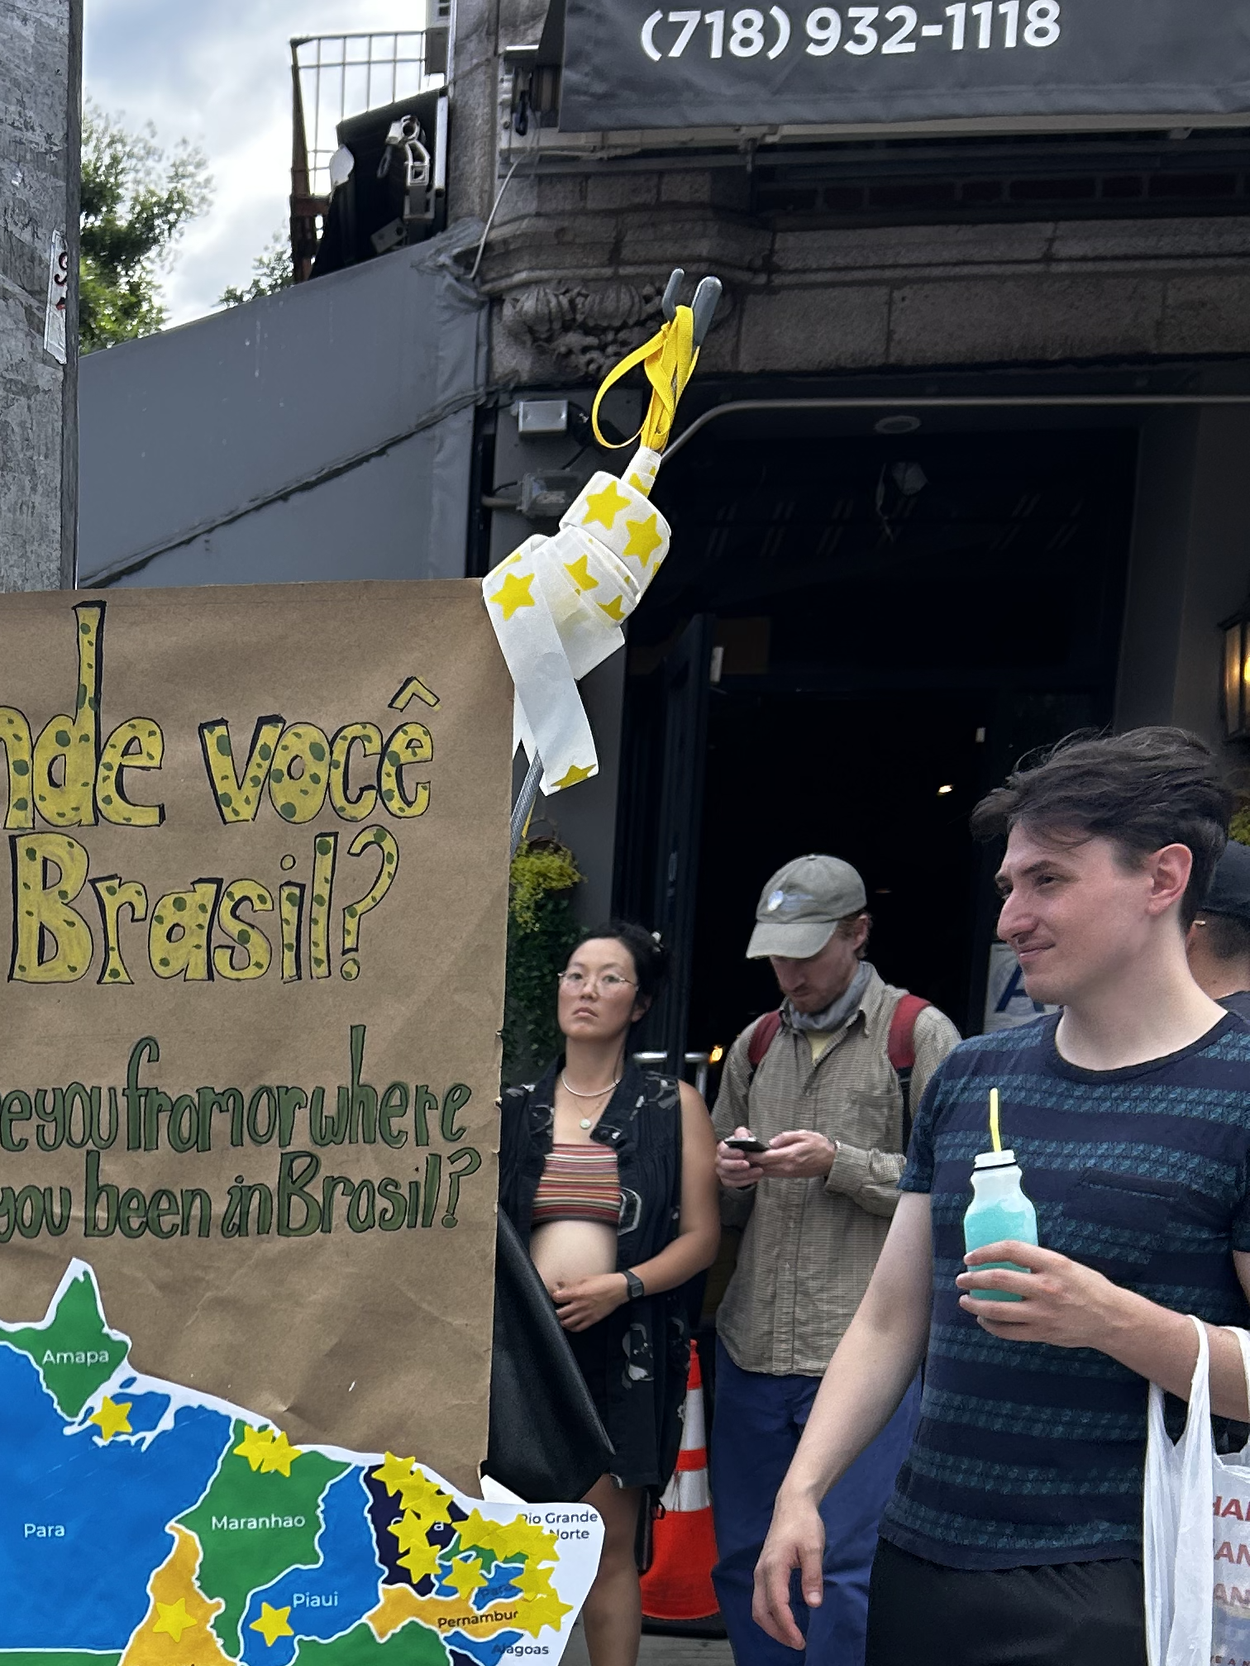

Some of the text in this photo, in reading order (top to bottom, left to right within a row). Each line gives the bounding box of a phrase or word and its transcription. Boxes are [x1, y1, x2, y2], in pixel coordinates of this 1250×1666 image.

[641, 0, 1061, 62] (718) 932-1118
[198, 676, 440, 826] você
[8, 825, 399, 985] Brasil?
[35, 1081, 118, 1152] you
[122, 1036, 244, 1152] from
[310, 1024, 472, 1150] where
[84, 1149, 211, 1239] been
[221, 1175, 273, 1239] in
[278, 1147, 482, 1238] Brasil?
[42, 1348, 110, 1367] Amapa
[211, 1514, 306, 1531] Maranhao
[545, 1509, 599, 1524] Grande
[23, 1522, 66, 1539] Para
[292, 1591, 339, 1608] Piaui
[437, 1611, 518, 1628] Pernambu
